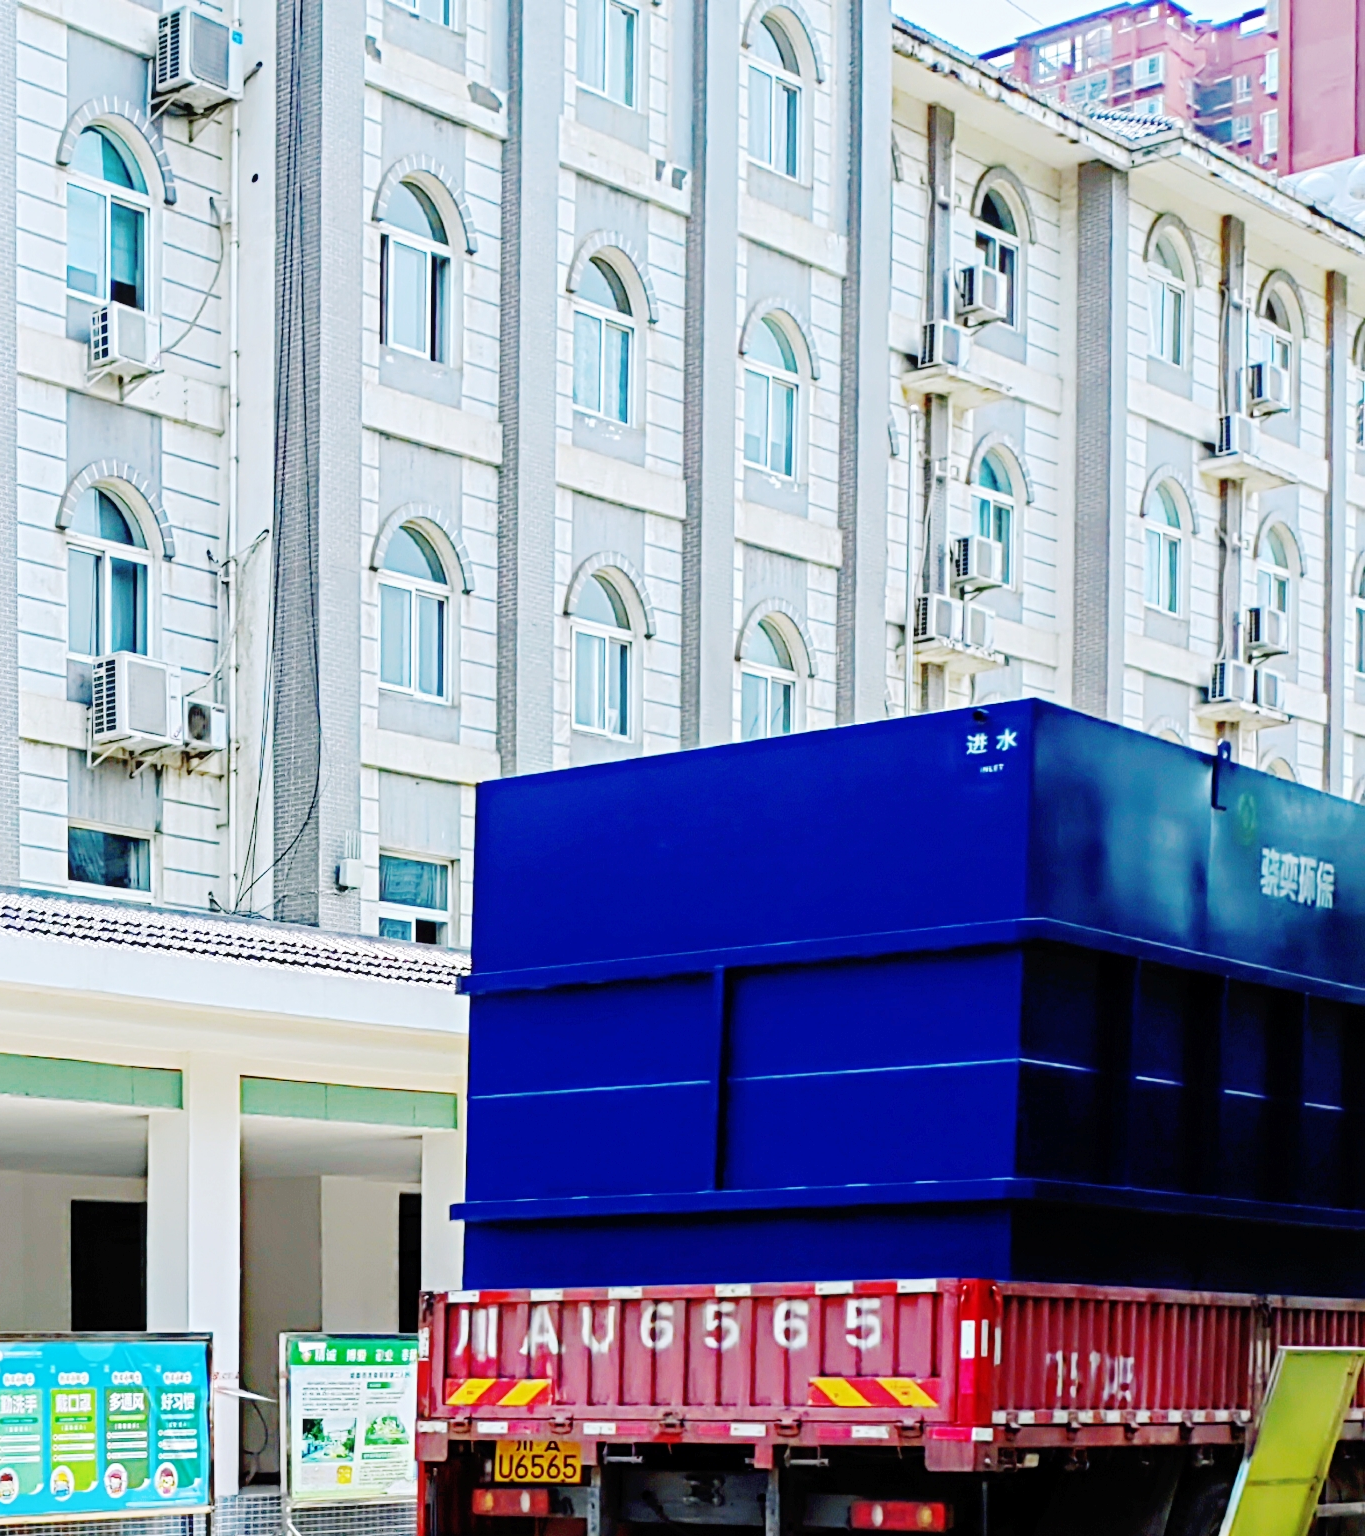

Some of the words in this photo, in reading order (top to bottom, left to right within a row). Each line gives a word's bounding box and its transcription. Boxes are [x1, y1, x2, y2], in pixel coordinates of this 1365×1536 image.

[966, 728, 1017, 754] 进水
[109, 1392, 145, 1412] 多通风
[160, 1392, 196, 1411] 好习惯
[499, 1454, 577, 1479] U6565
